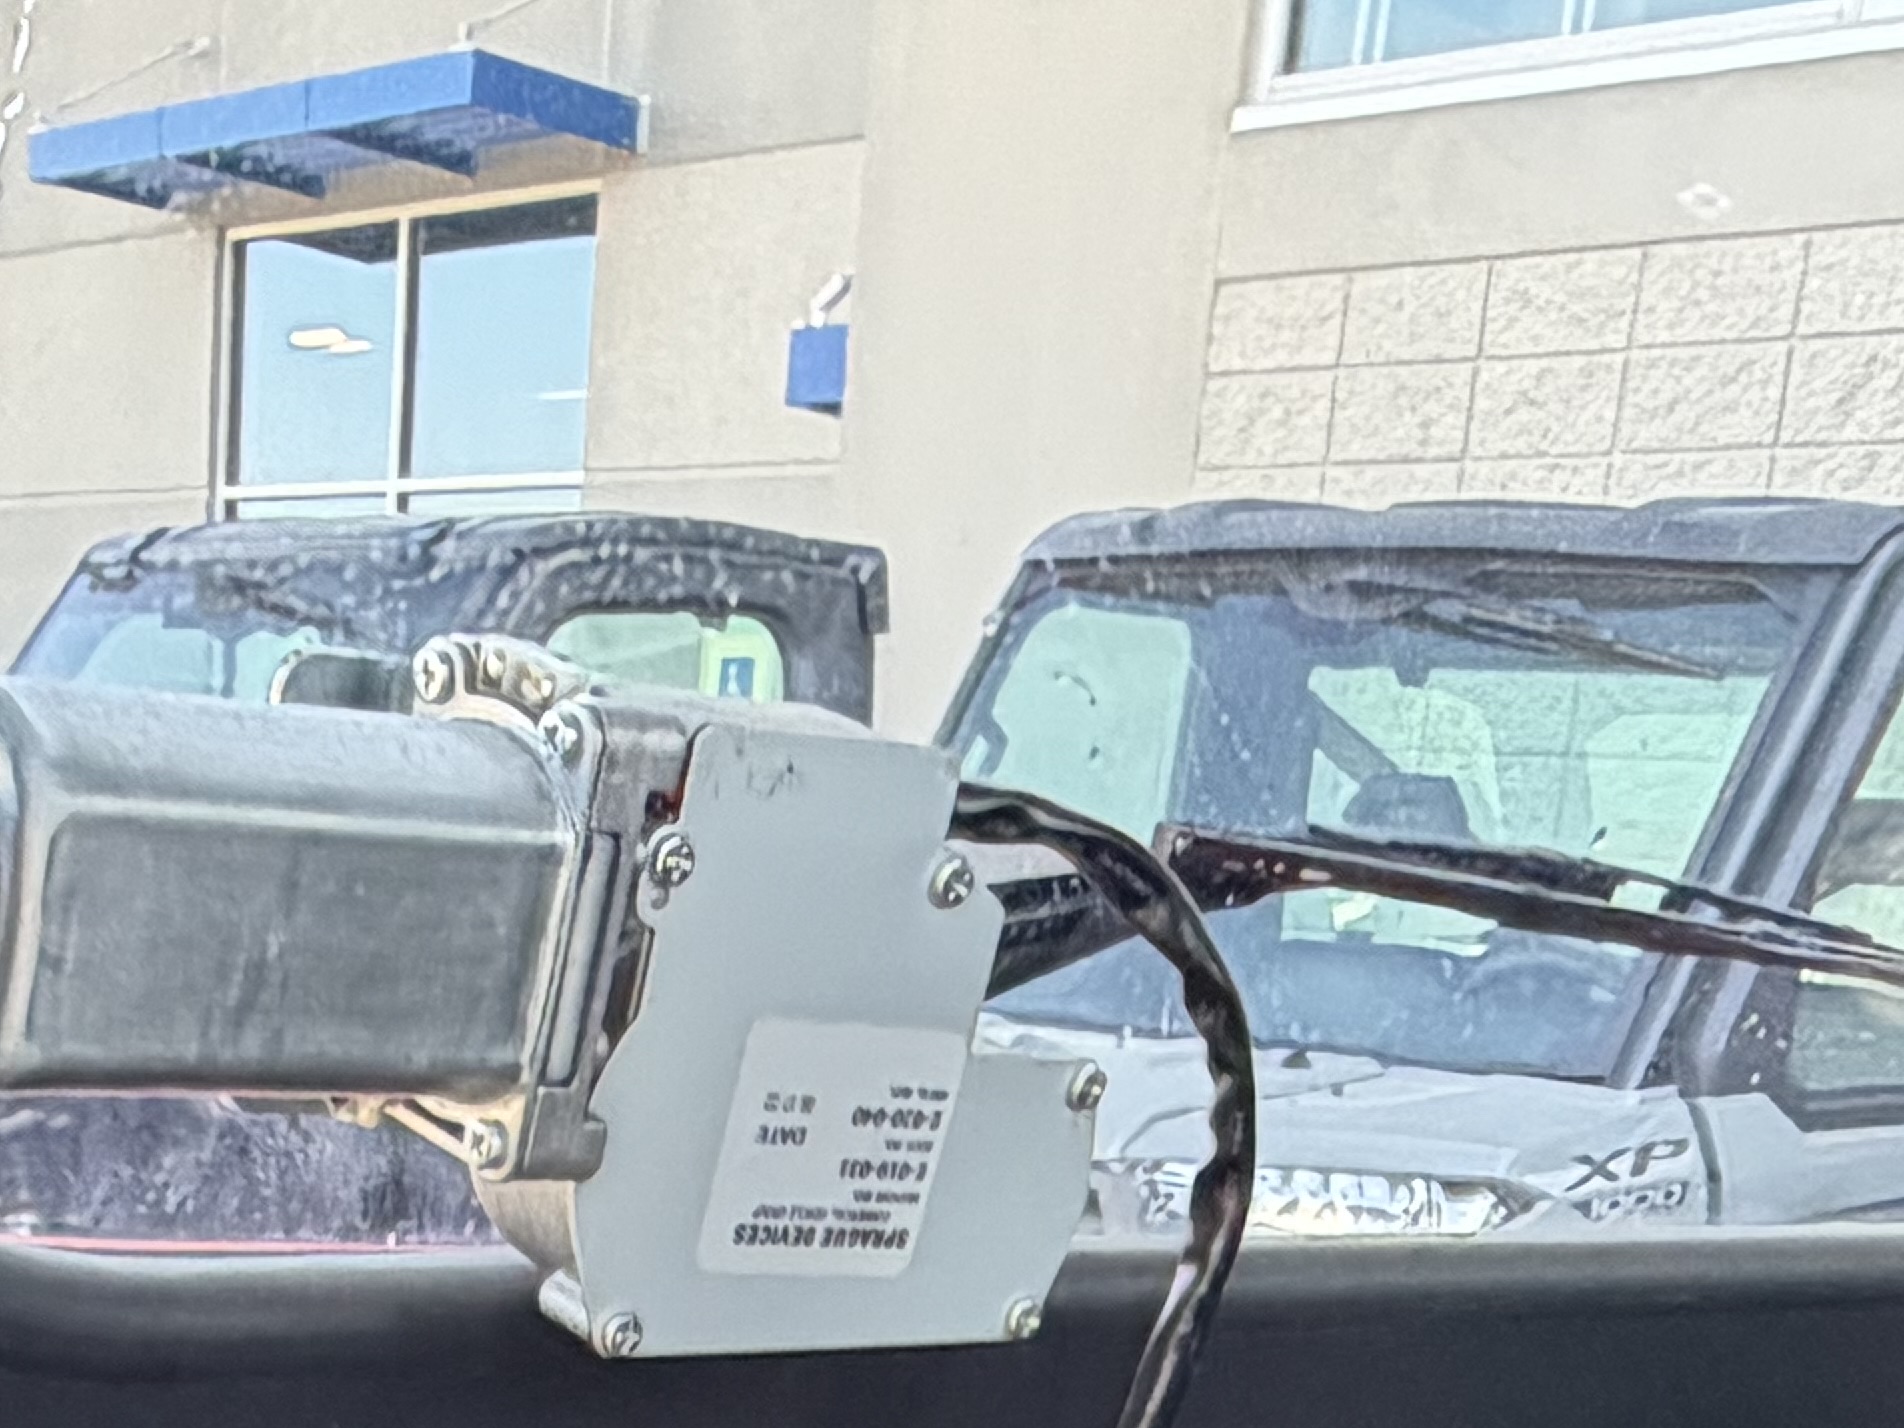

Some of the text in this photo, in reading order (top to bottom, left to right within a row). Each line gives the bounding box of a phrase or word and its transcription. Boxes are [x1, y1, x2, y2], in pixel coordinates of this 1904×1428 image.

[754, 1124, 808, 1147] DATE
[1564, 1137, 1690, 1193] XP
[732, 1223, 910, 1250] SPRAGUE DEVICES
